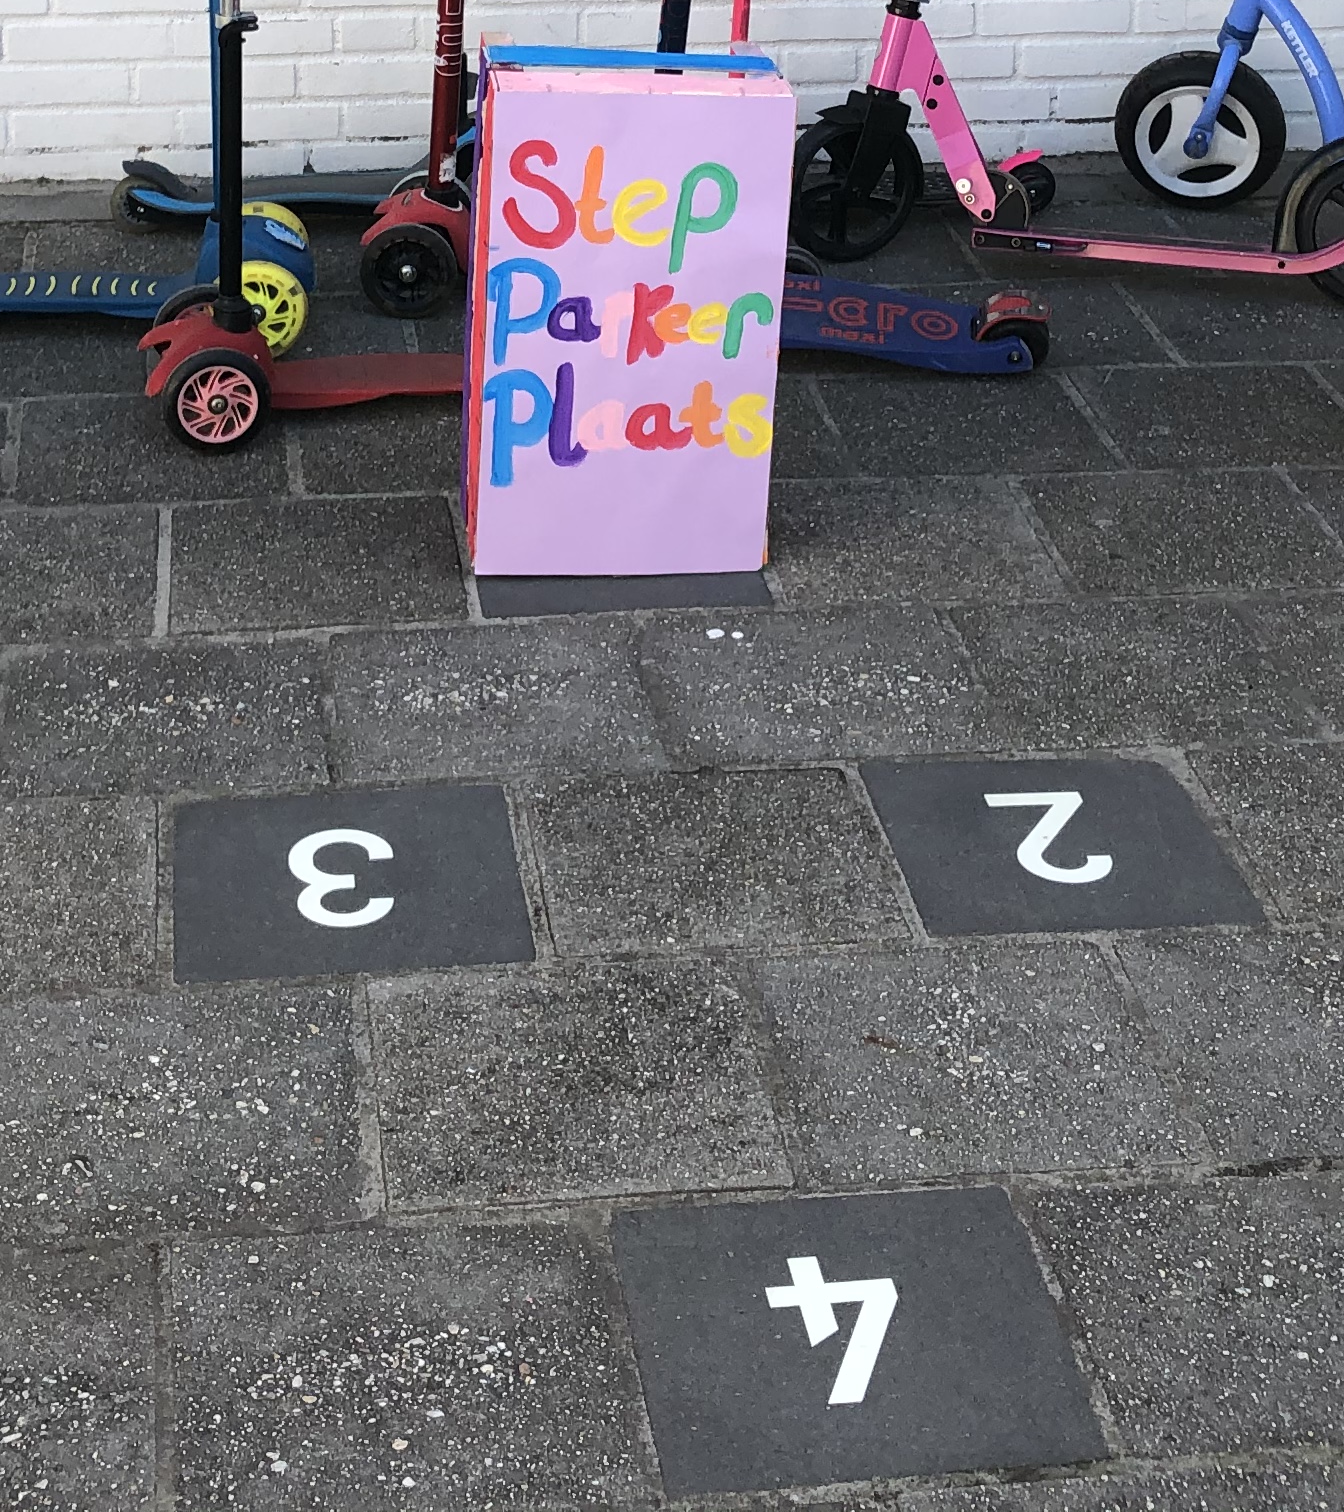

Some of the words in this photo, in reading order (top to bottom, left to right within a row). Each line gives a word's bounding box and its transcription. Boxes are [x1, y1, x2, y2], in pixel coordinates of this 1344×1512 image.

[1281, 20, 1319, 79] KETTLER
[502, 139, 739, 274] Step
[819, 325, 885, 345] maxi
[483, 362, 774, 488] Plaats
[287, 828, 395, 928] 3
[983, 790, 1113, 884] 2
[764, 1255, 898, 1405] 4
